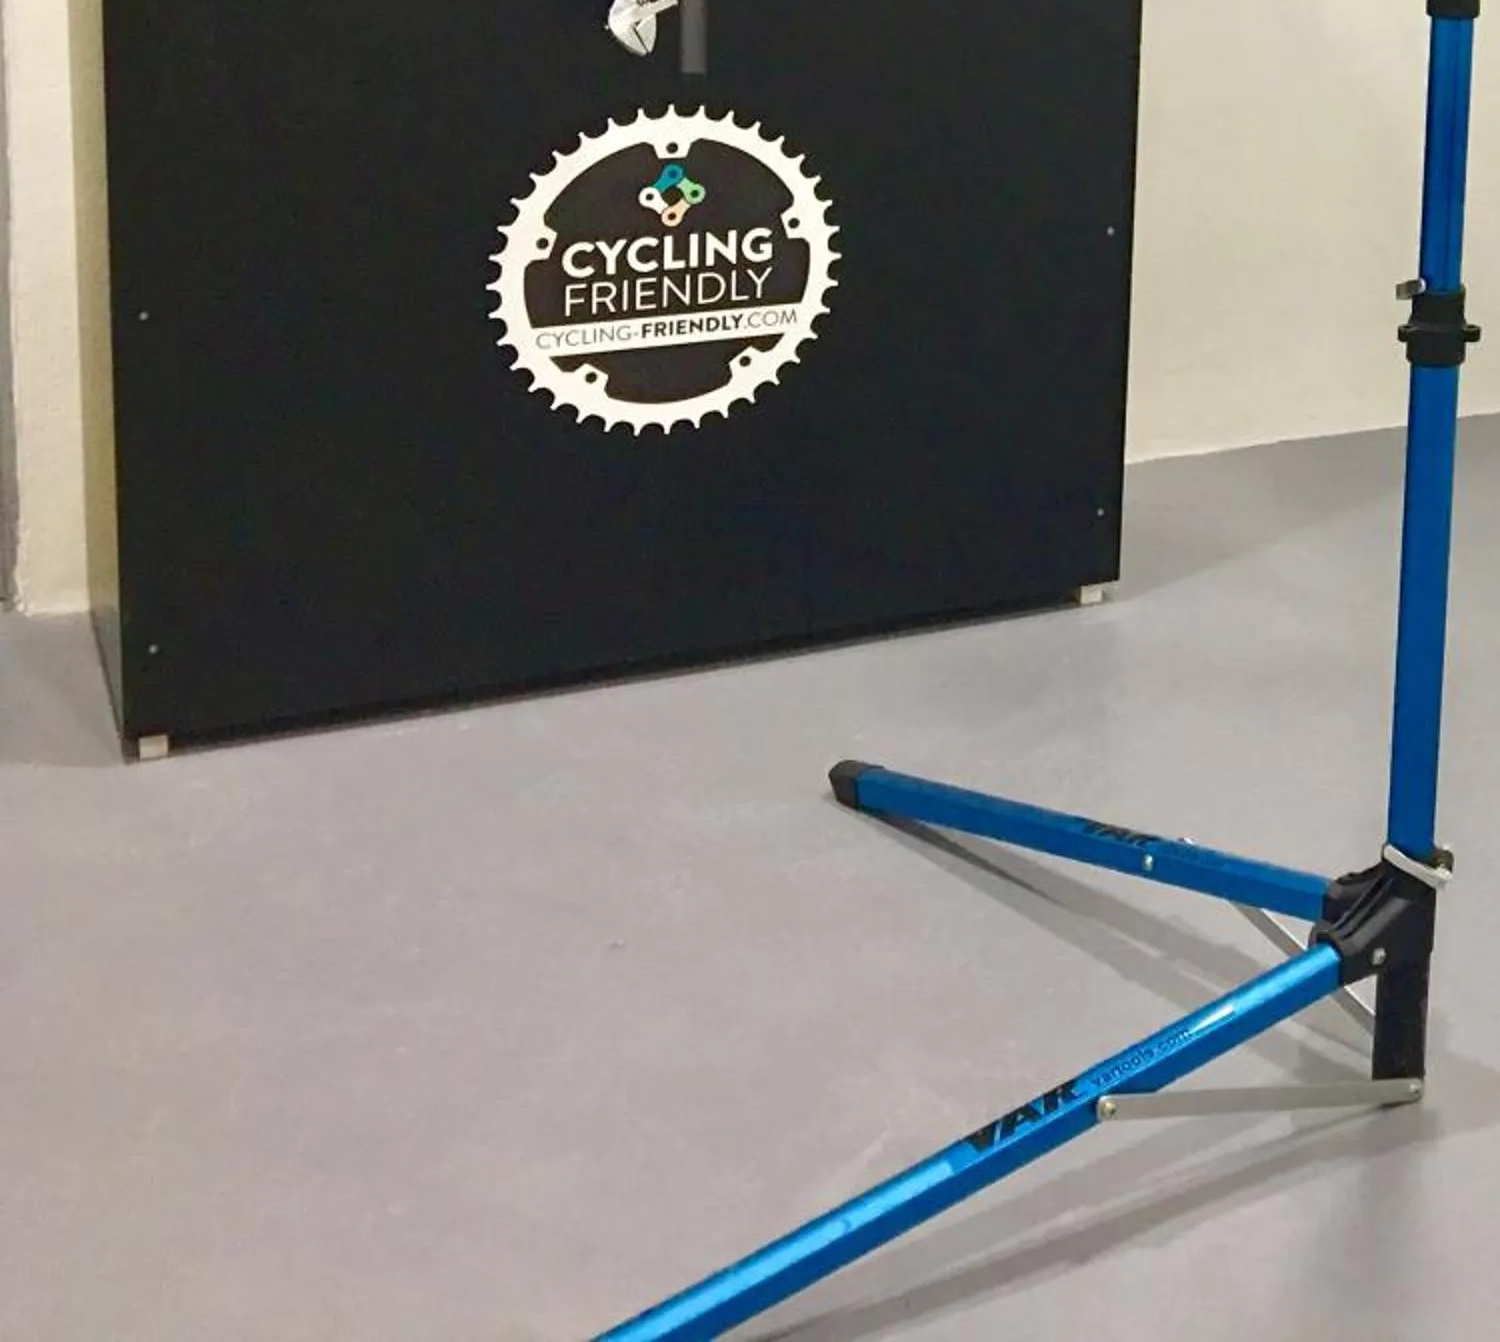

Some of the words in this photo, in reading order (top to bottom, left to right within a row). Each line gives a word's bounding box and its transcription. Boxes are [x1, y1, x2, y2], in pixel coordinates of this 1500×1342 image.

[561, 228, 774, 279] CYCLING
[563, 266, 774, 318] FRIENDLY
[534, 307, 798, 350] CYCLING-FRIENDLY.COM
